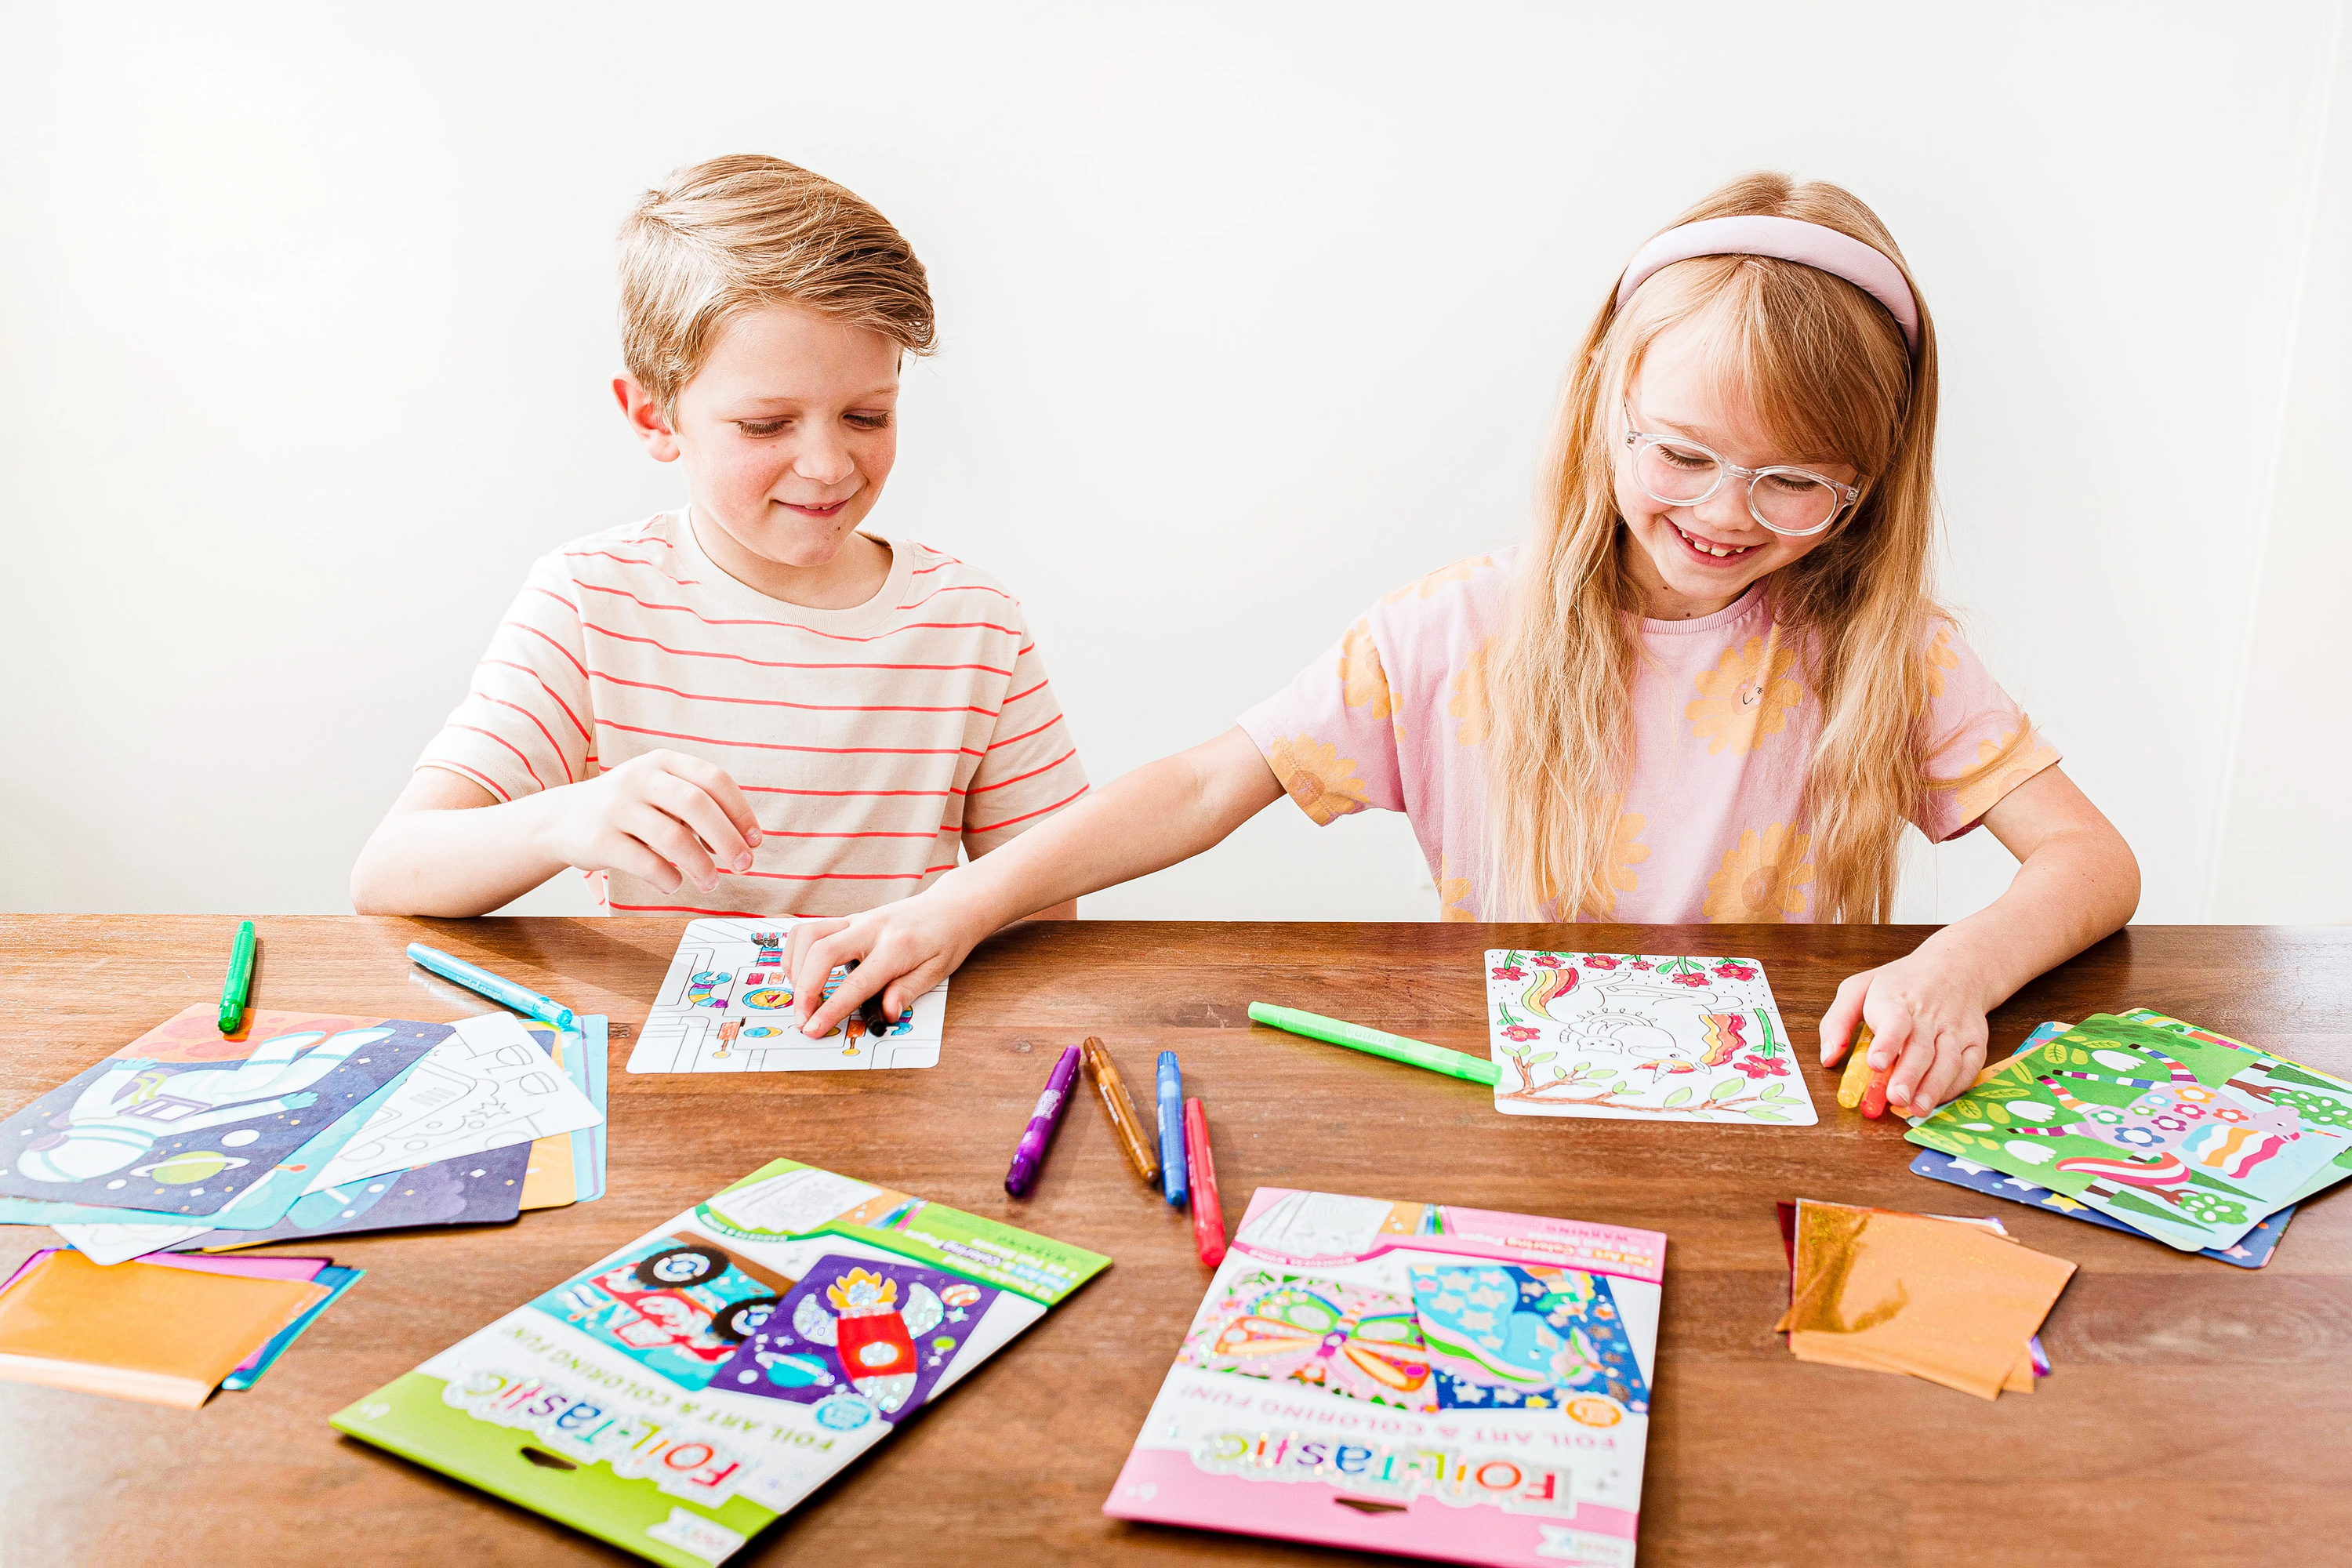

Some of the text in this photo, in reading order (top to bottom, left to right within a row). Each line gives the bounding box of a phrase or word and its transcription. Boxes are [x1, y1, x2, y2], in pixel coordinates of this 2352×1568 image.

[548, 1349, 672, 1408] COLORING
[702, 1412, 762, 1432] ART
[1259, 1399, 1425, 1438] COLORING
[771, 1427, 834, 1452] FOIL
[1470, 1428, 1532, 1445] ART
[1542, 1432, 1617, 1450] FOIL
